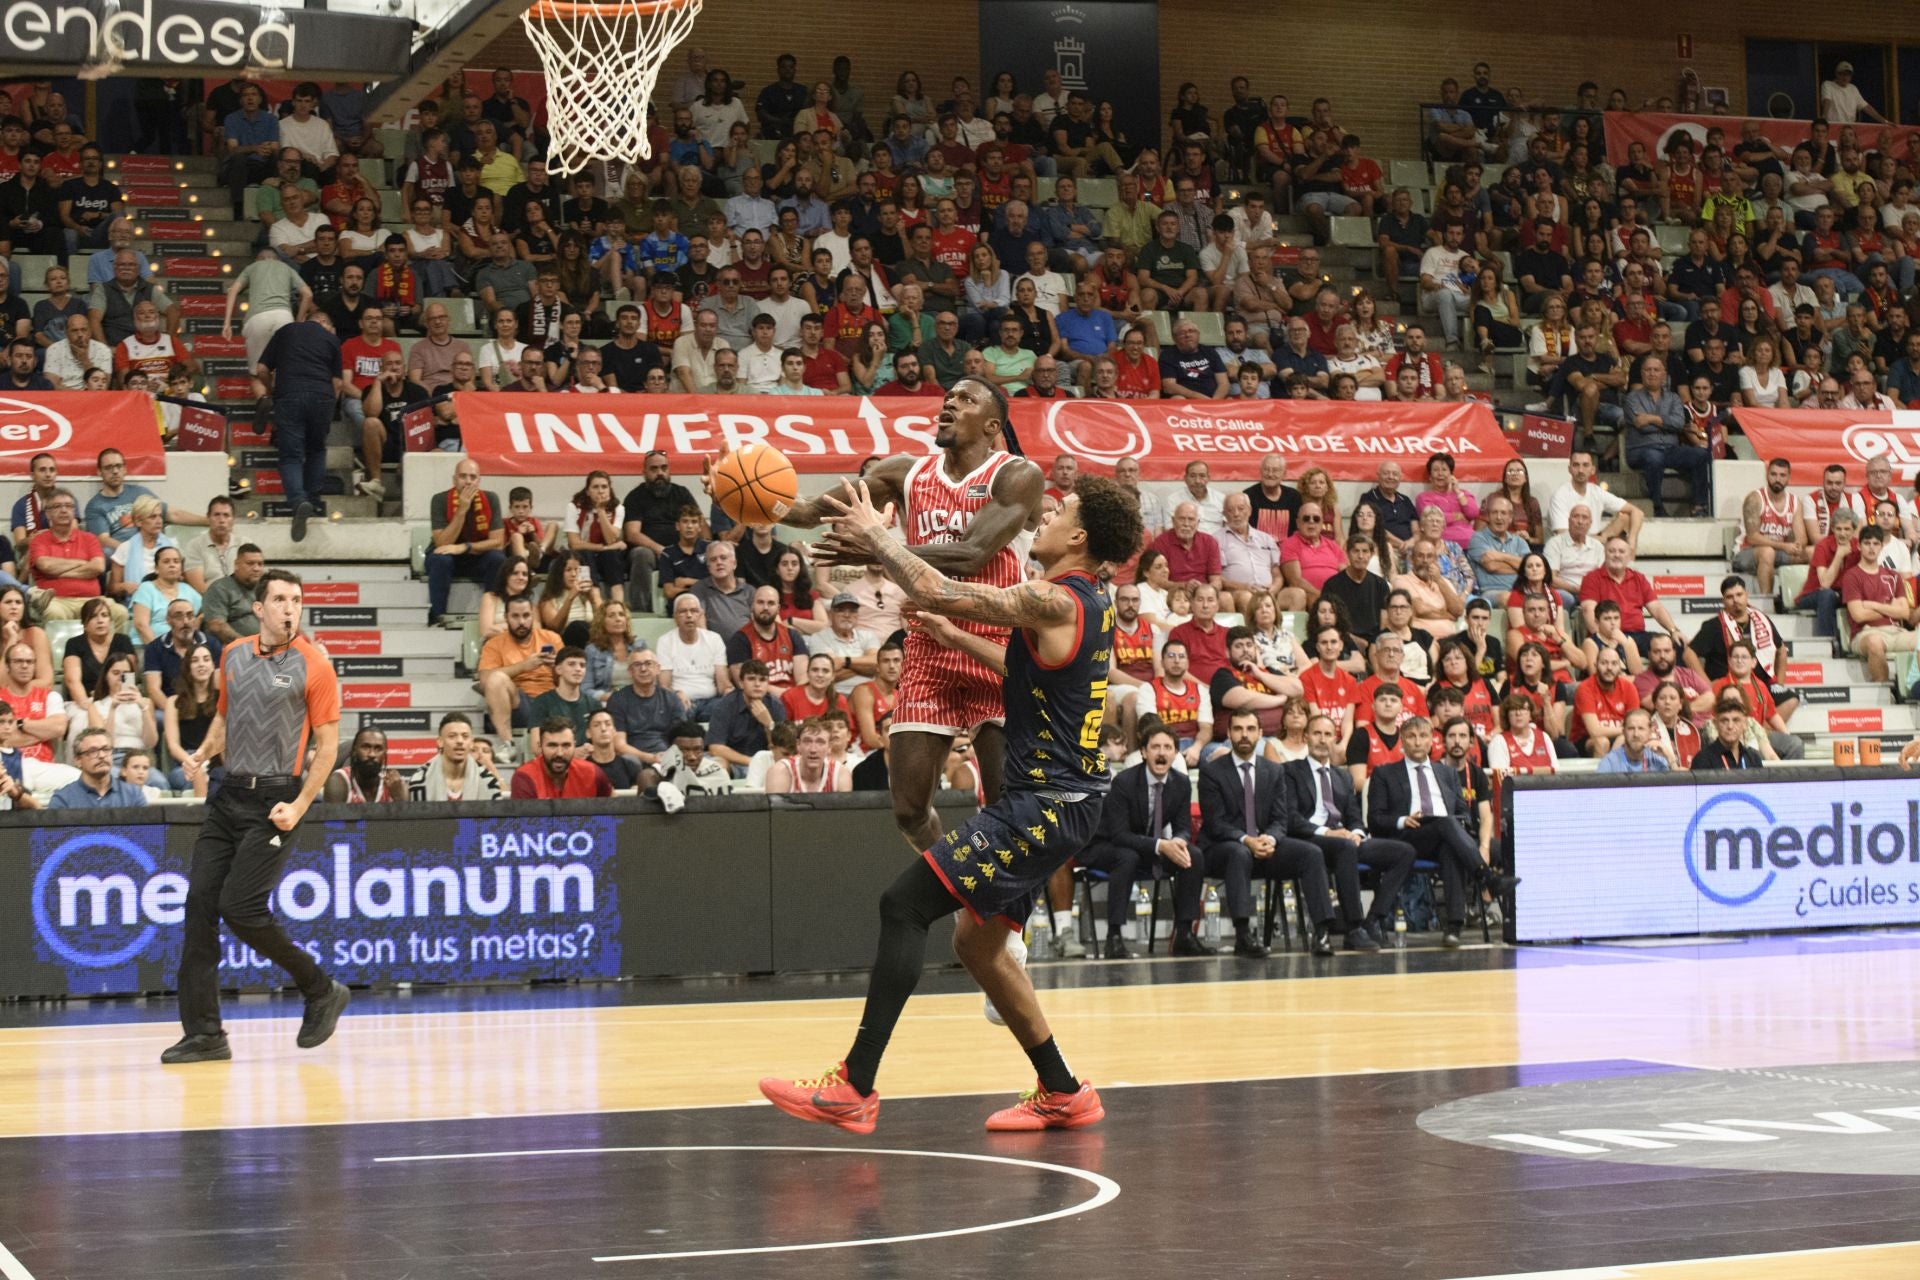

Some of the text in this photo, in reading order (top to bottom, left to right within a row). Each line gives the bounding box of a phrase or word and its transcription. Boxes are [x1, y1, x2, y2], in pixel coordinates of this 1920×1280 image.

[4, 0, 295, 69] endesa
[76, 196, 109, 210] Jeep
[936, 251, 967, 263] UCAM
[1179, 358, 1210, 368] Reebok
[185, 422, 219, 439] MÓDULO
[1167, 415, 1264, 433] Costa Cálida
[197, 438, 204, 446] 7
[1172, 431, 1482, 455] REGIÓN DE MURCIA
[1528, 429, 1566, 444] MÓDULO
[1117, 646, 1153, 659] UCAM
[1704, 800, 1919, 871] mediol
[481, 831, 594, 859] BANCO
[57, 843, 594, 926] meolanum
[1795, 876, 1899, 916] ¿Cuáles
[334, 937, 396, 965] son
[408, 931, 459, 963] tus
[470, 923, 595, 961] metas?
